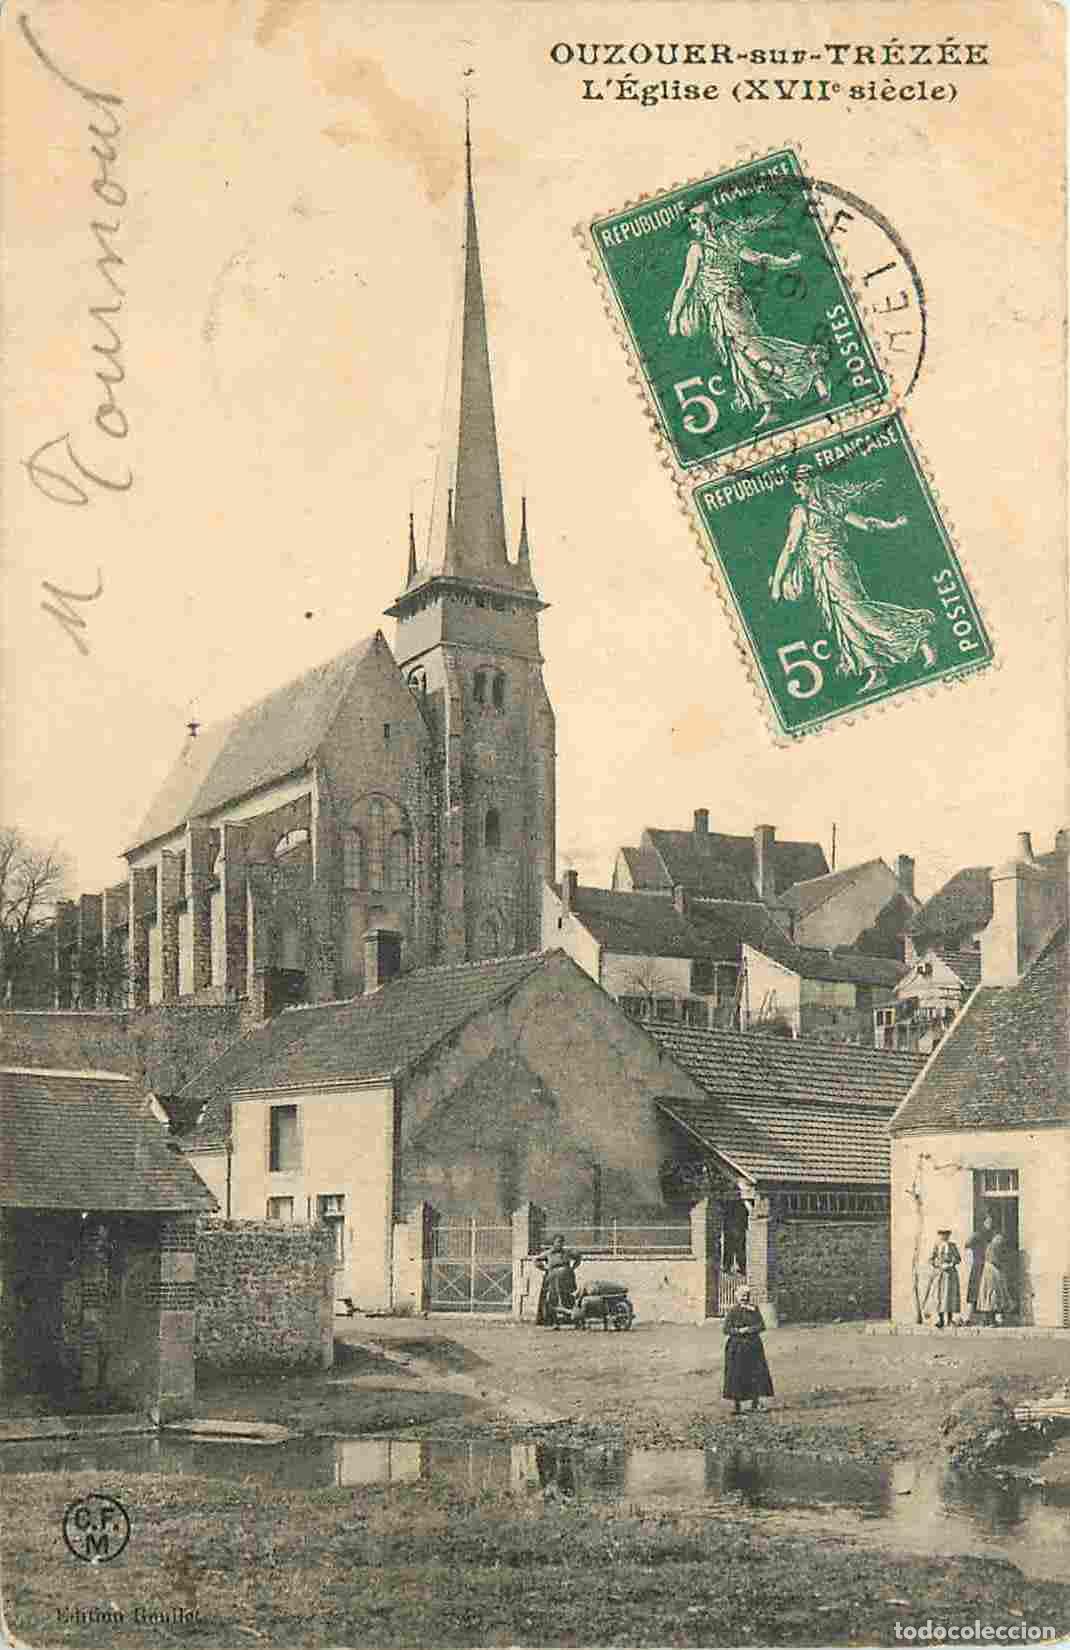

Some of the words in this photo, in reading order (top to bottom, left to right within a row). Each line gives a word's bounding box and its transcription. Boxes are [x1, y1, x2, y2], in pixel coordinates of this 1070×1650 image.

[549, 37, 990, 66] OUZOUER-sur-TRÉZÉE
[581, 74, 720, 106] L'Église
[848, 77, 959, 102] siècle)
[824, 303, 874, 390] POSTES
[702, 463, 791, 512] REPUBLIQUE
[931, 567, 980, 653] POSTES
[84, 1533, 110, 1555] M
